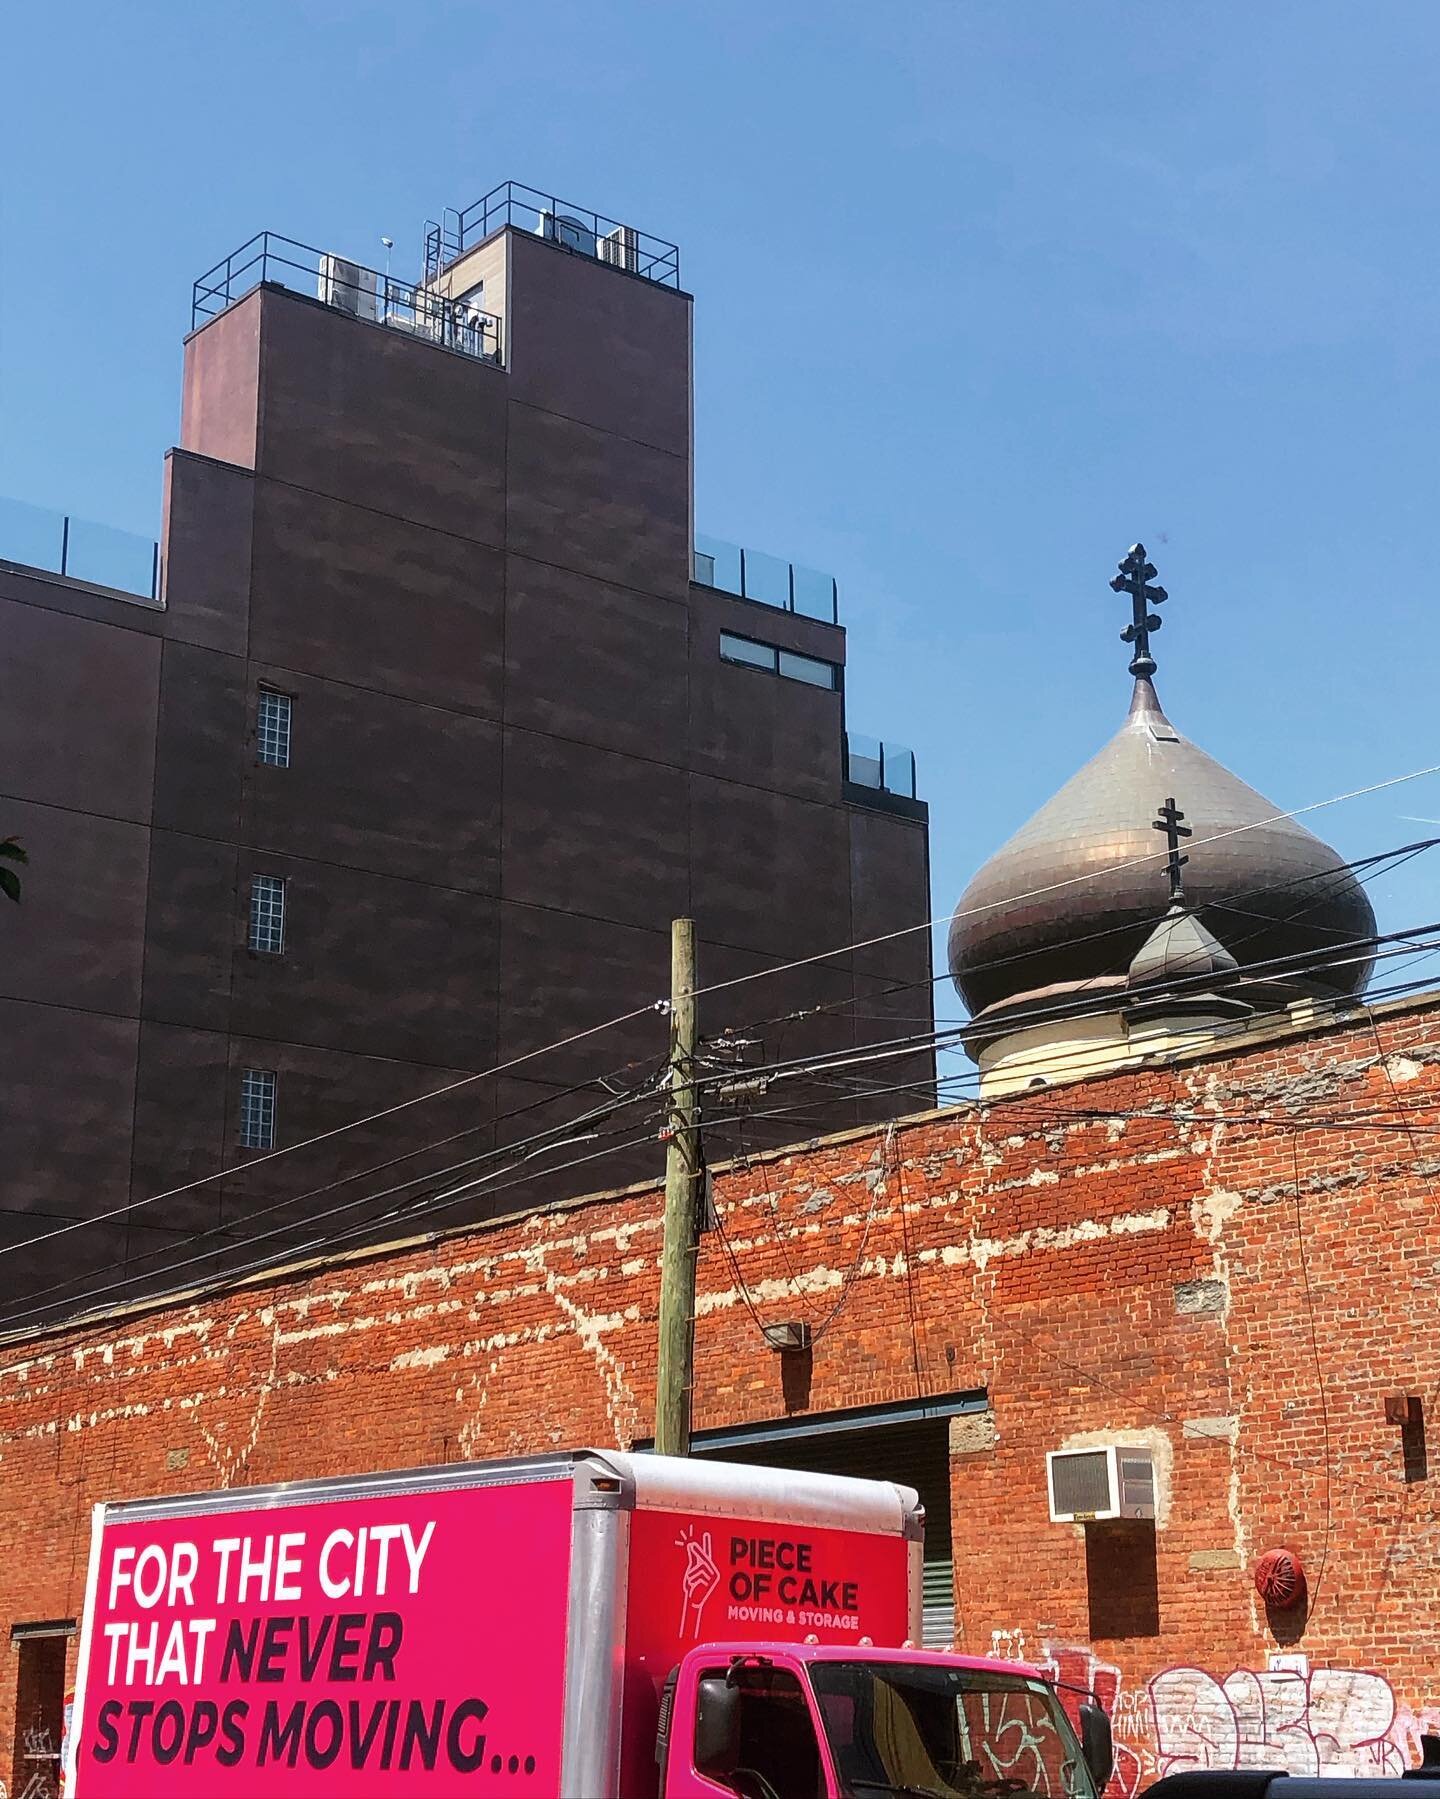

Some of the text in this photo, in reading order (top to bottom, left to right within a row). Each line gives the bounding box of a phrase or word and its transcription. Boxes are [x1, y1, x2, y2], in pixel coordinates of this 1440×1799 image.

[108, 1521, 436, 1610] FOR THE CITY
[730, 1537, 812, 1572] PIECE
[728, 1605, 859, 1630] MOVING & STORAGE
[729, 1572, 859, 1611] OF CAKE
[104, 1612, 404, 1686] THAT NEVER
[92, 1700, 250, 1766] STOPS
[256, 1699, 536, 1774] MOVING...
